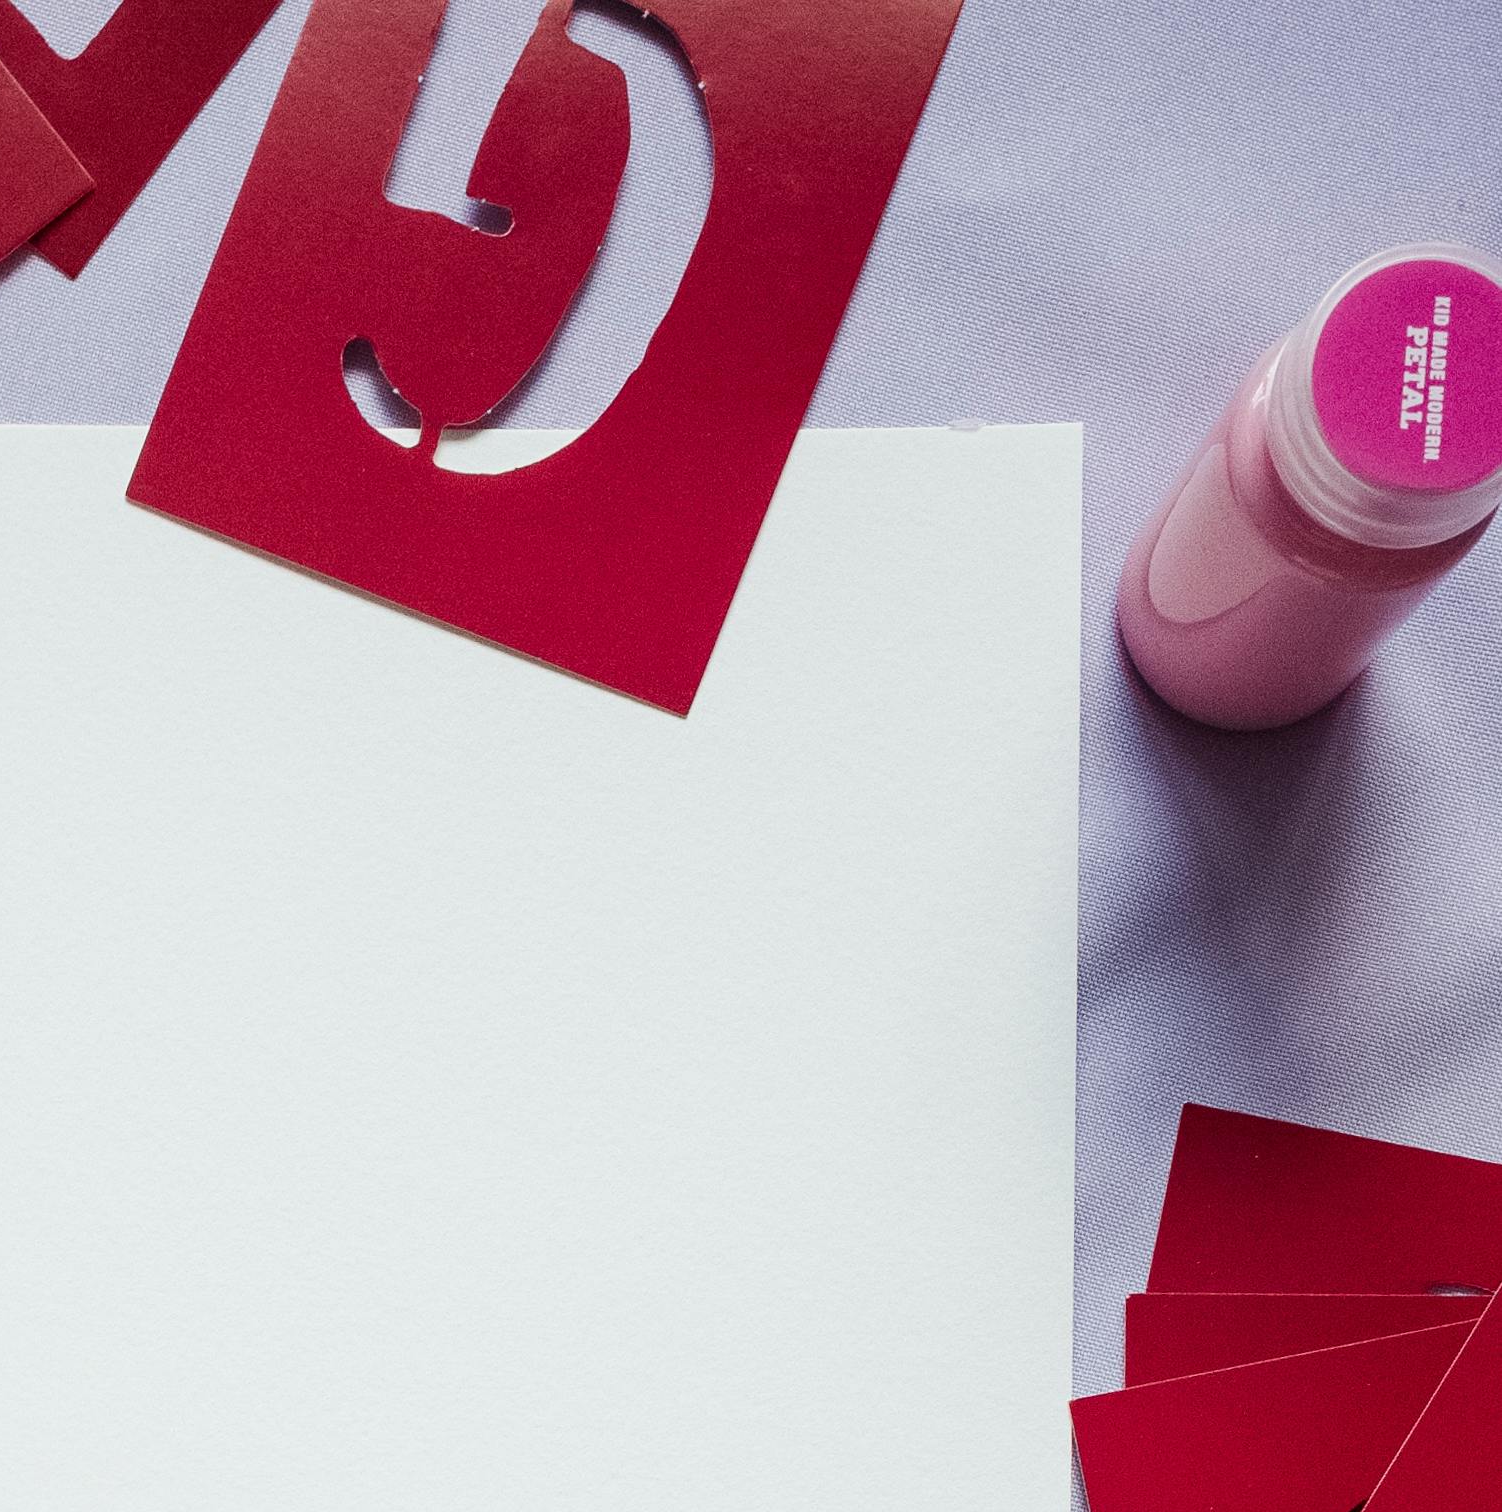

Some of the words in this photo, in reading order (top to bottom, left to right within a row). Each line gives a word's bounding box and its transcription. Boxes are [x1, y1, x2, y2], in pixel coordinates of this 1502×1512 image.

[1433, 296, 1451, 326] KID
[1400, 325, 1429, 430] PETAL
[1429, 331, 1448, 380] MADE
